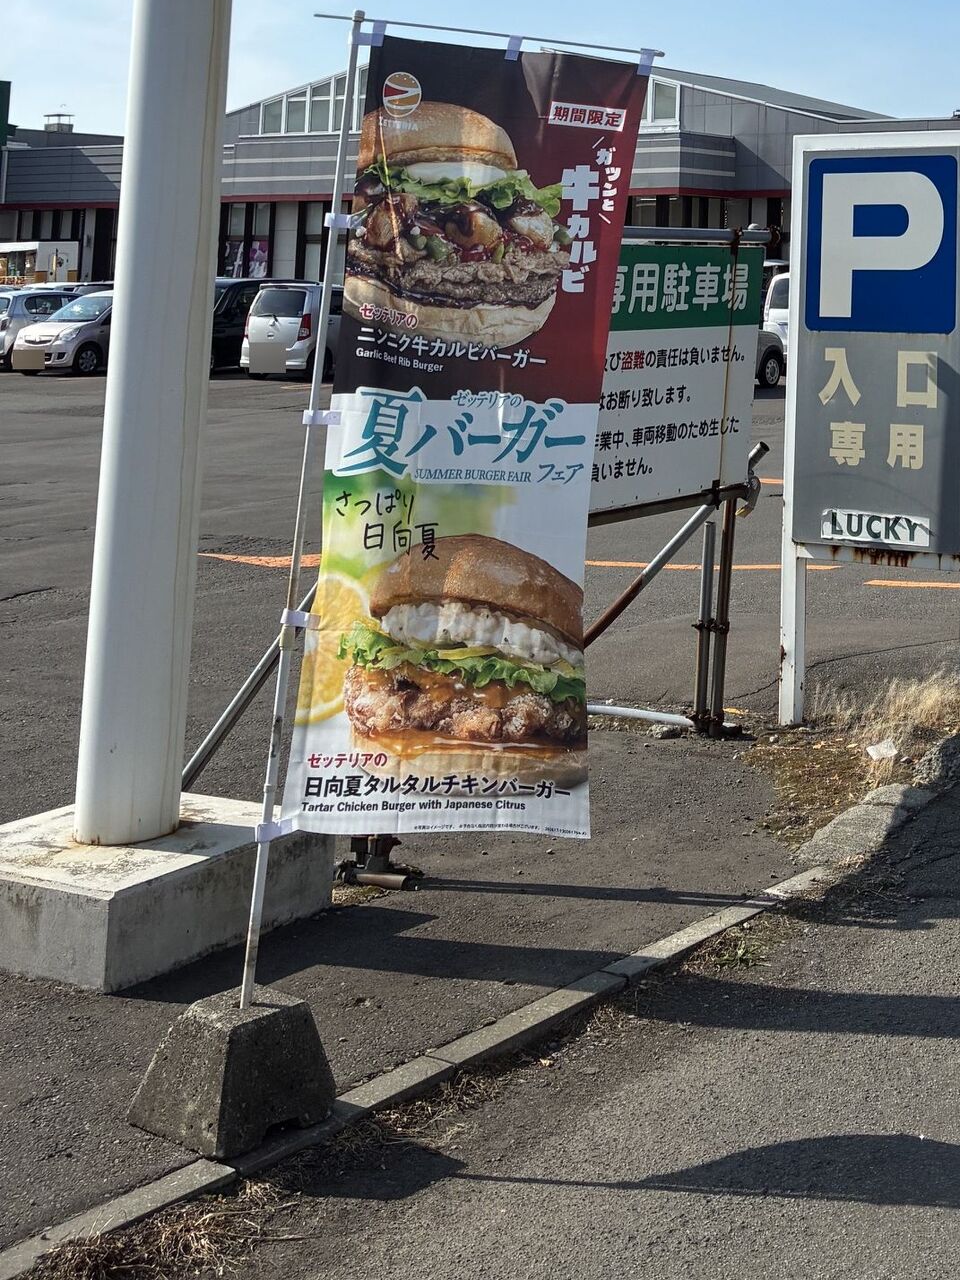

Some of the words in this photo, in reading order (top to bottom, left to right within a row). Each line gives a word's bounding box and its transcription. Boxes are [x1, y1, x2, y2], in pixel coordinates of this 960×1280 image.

[554, 106, 622, 128] 期間限定
[596, 147, 621, 212] ガツンと
[561, 165, 600, 293] 牛カルビ
[819, 171, 944, 317] P
[360, 303, 418, 329] ゼッテリアの
[356, 347, 383, 360] Garlic
[398, 356, 411, 368] Rib
[413, 359, 444, 373] Burger
[357, 327, 547, 369] ニンニク牛カルビバーガー
[818, 347, 938, 408] 入口
[453, 391, 522, 409] ゼッテリアの
[337, 391, 587, 475] 夏バーガー
[829, 421, 924, 470] 専用
[415, 468, 462, 481] SUMMER
[464, 468, 506, 482] BURGER
[507, 470, 531, 482] FAIR
[538, 464, 584, 484] フェア
[364, 520, 439, 560] 日向夏
[831, 512, 918, 542] LUCKY
[307, 753, 388, 769] ゼッテリアの
[304, 775, 571, 799] 日向夏タルタルチキンバーガー
[301, 802, 335, 812] Tartar
[337, 801, 378, 811] Chicken
[381, 800, 416, 813] Burger
[419, 800, 442, 810] with
[444, 800, 493, 812] Japanese
[495, 800, 526, 810] Citrus
